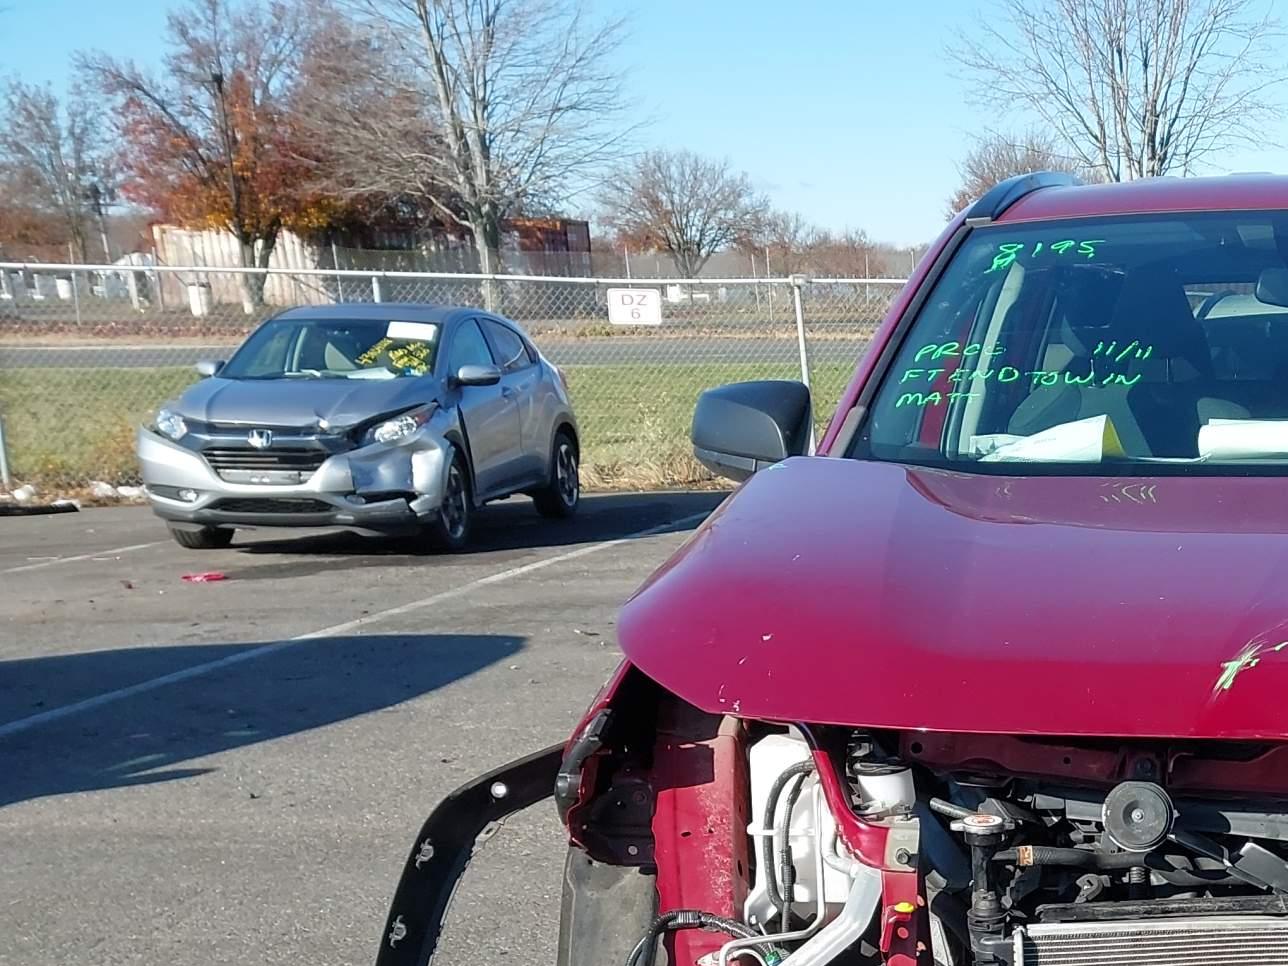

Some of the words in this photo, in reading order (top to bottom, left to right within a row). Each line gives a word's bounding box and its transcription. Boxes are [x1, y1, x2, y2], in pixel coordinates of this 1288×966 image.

[621, 294, 648, 306] DZ
[631, 307, 641, 320] 6
[1093, 340, 1153, 362] 11/11
